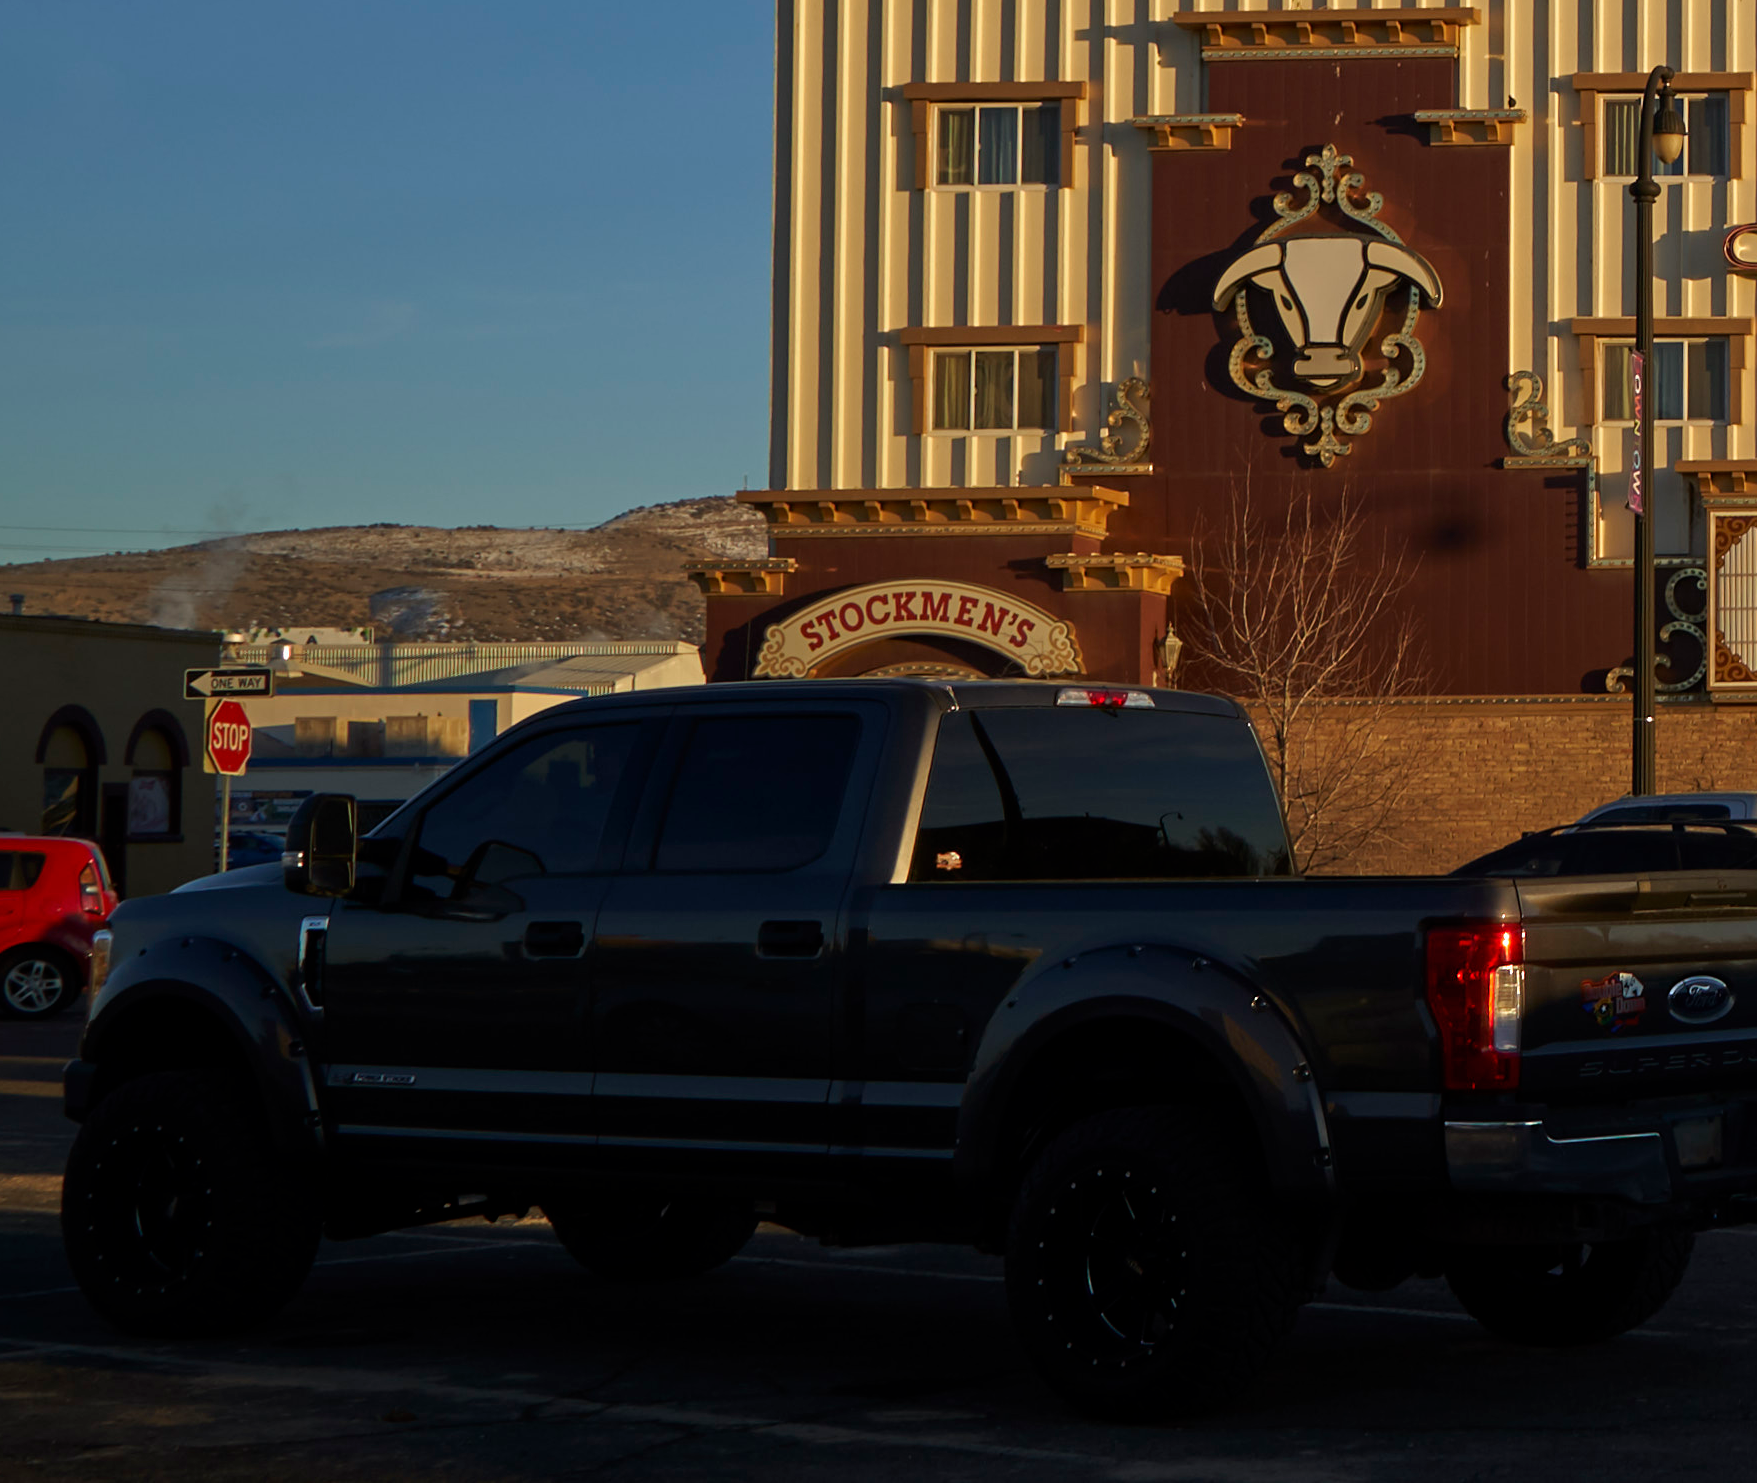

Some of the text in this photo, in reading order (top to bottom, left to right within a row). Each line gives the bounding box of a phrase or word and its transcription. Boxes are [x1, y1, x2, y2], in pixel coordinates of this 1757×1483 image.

[801, 591, 1036, 652] STOCKMEN'S
[210, 675, 262, 690] ONE WAY
[212, 721, 249, 752] STOP
[1684, 984, 1718, 1009] Ford
[1579, 1052, 1714, 1077] SUPER
